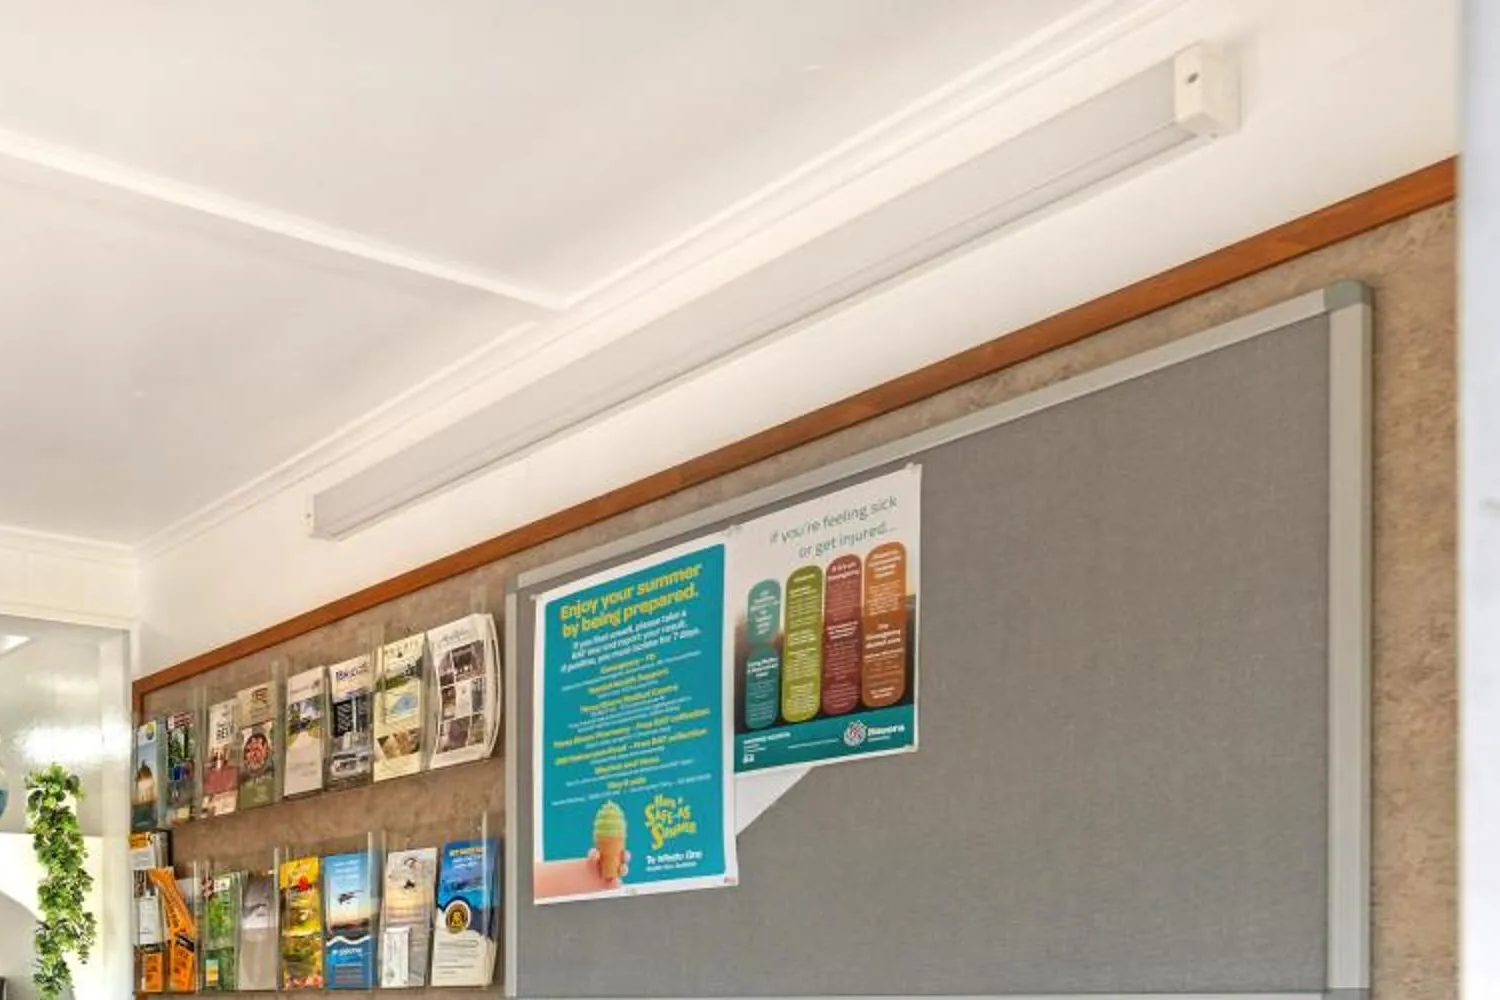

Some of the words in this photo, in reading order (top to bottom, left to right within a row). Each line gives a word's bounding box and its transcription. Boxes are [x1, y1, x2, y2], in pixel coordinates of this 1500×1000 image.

[781, 520, 821, 543] you're
[823, 505, 869, 529] feeling
[870, 496, 898, 512] sick
[798, 546, 813, 559] or
[815, 537, 837, 557] get
[561, 596, 599, 620] Enjoy
[601, 584, 635, 611] your
[636, 563, 703, 595] summer
[561, 623, 579, 638] by
[581, 607, 621, 628] being
[623, 582, 700, 622] prepared.
[635, 617, 661, 632] please
[659, 634, 672, 645] for
